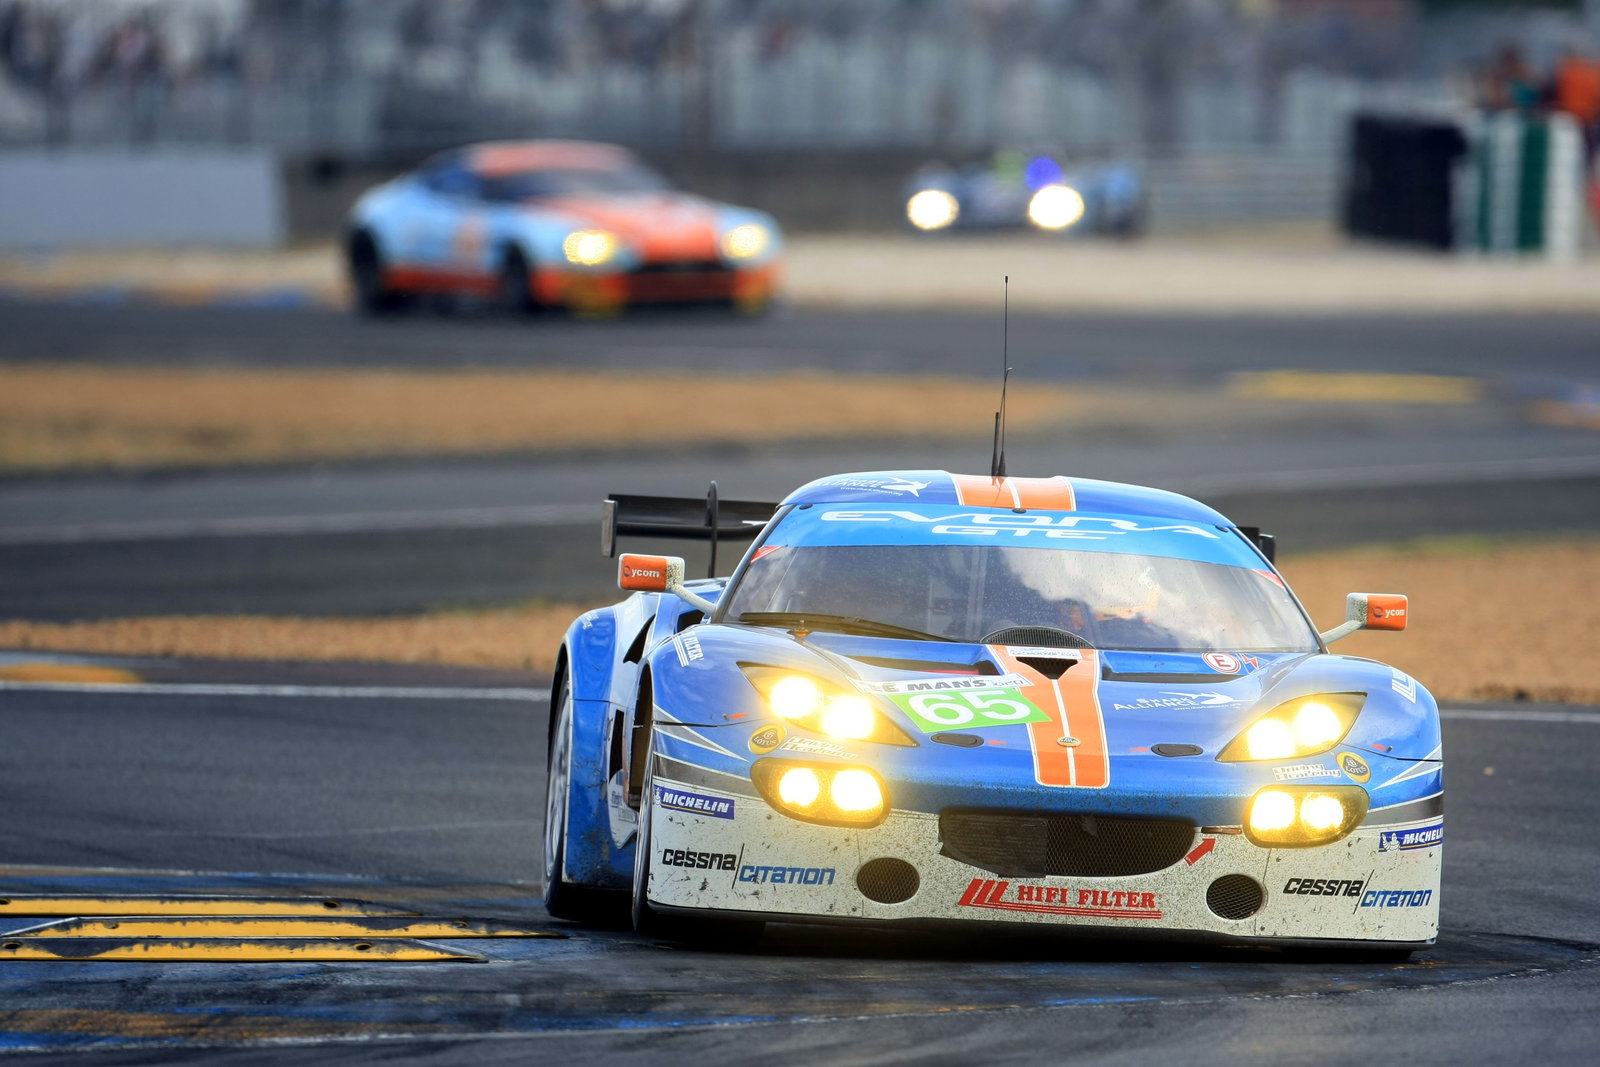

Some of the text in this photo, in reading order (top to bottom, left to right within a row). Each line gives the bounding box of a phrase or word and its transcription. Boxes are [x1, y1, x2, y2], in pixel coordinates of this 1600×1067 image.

[820, 510, 1220, 540] EVORA
[931, 525, 1127, 540] GTE
[631, 568, 660, 578] ycom
[1213, 655, 1232, 667] E
[908, 689, 1031, 726] 65
[1113, 699, 1200, 711] ALLIANCE
[753, 737, 778, 746] LOTUS
[1346, 766, 1370, 775] LOTUS
[662, 792, 730, 814] MICHELIN
[1017, 885, 1157, 909] HIFI FILTER
